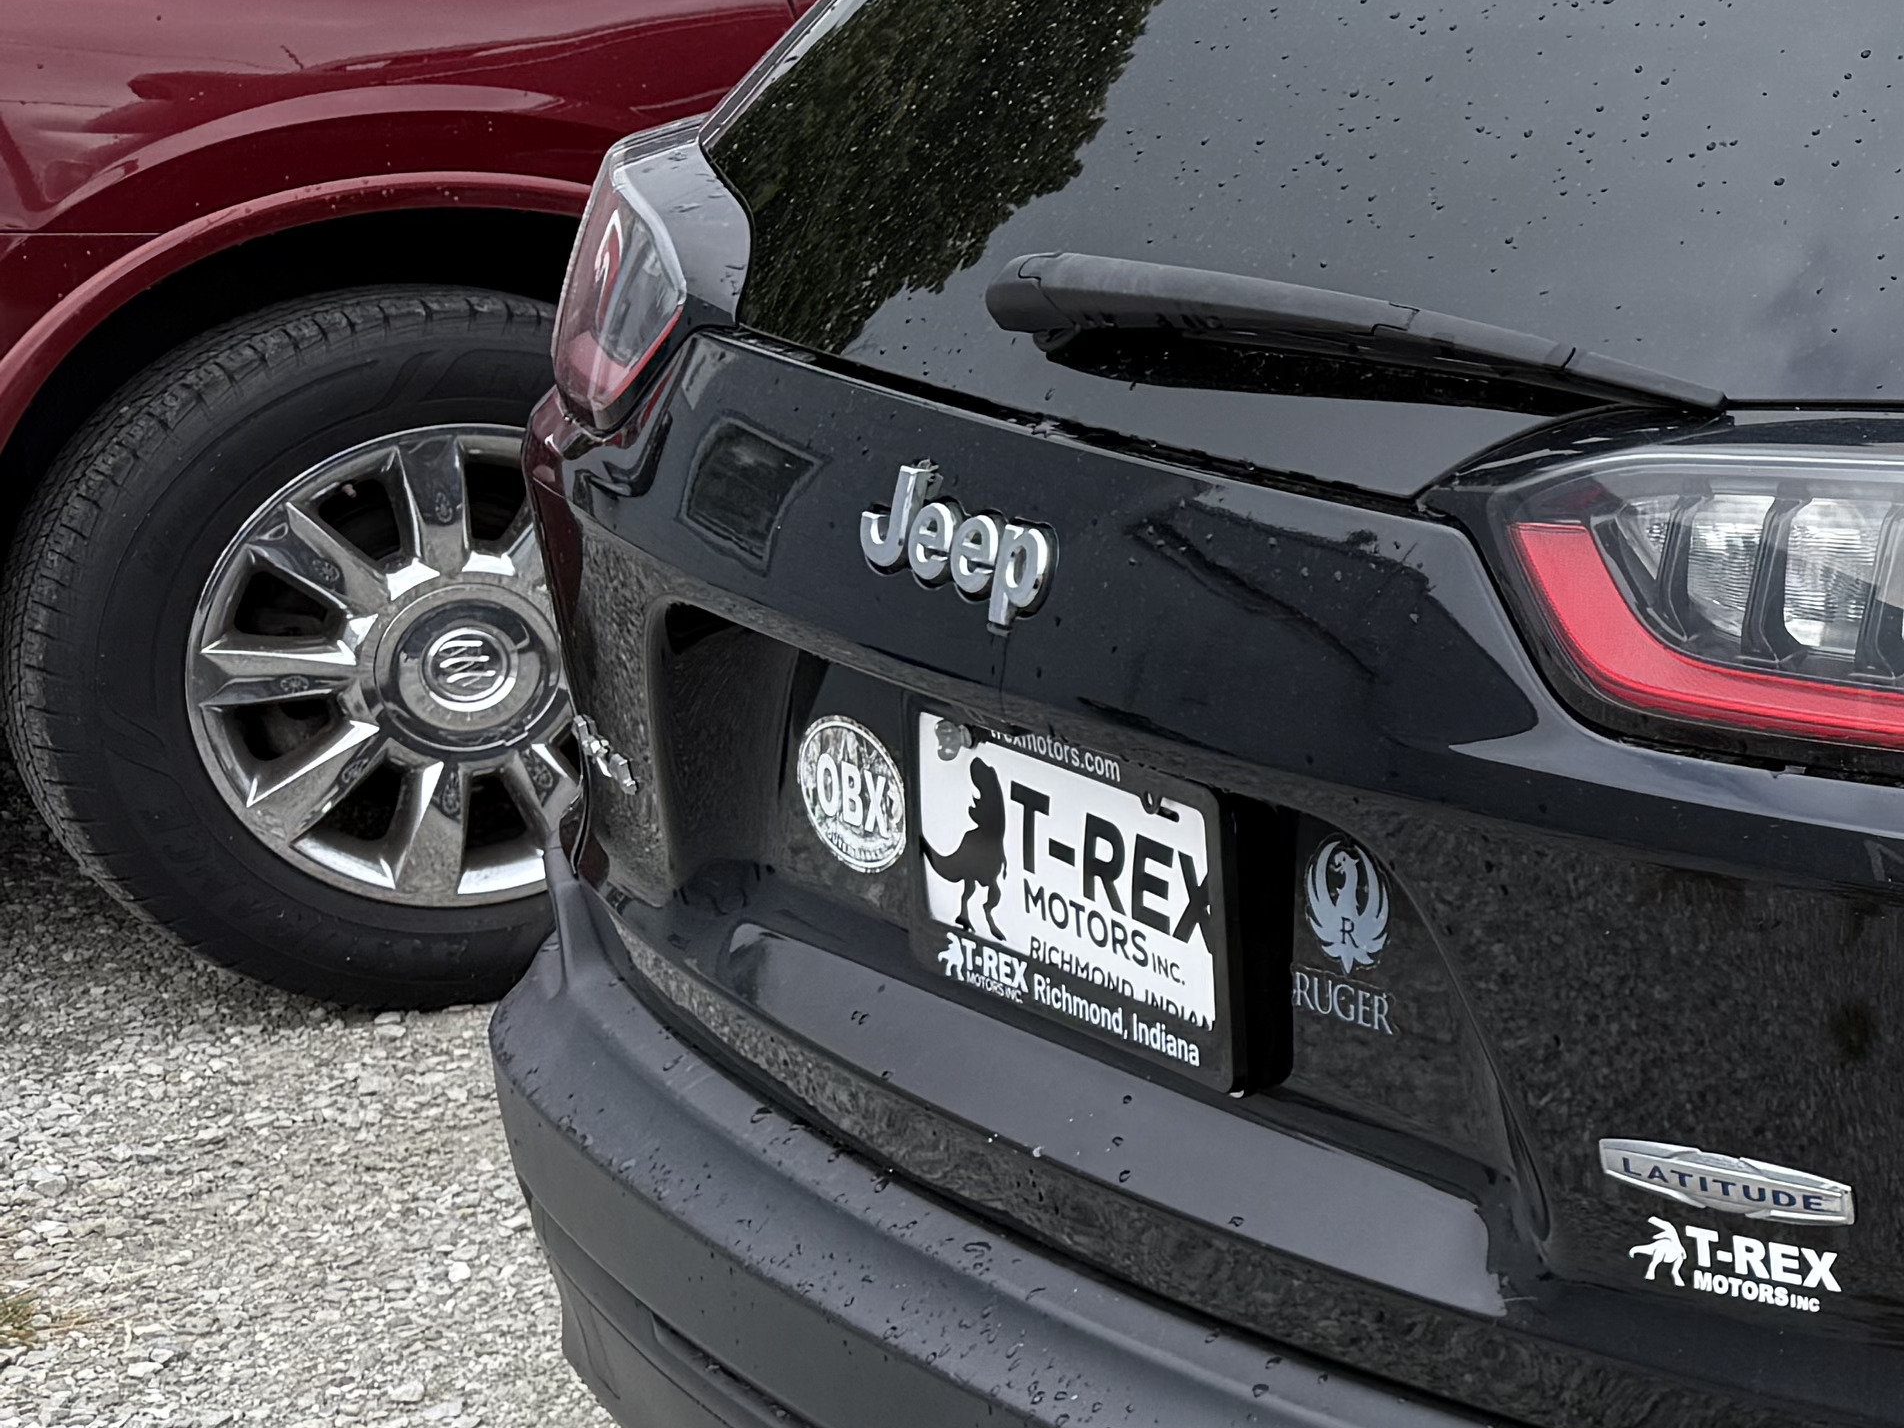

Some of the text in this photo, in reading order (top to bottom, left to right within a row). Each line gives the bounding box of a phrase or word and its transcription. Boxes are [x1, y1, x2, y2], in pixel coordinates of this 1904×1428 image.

[860, 460, 1051, 633] Jeep
[816, 753, 890, 840] OBX
[1010, 781, 1213, 955] T-REX
[961, 937, 1029, 994] T-REX
[1023, 876, 1186, 987] MOTORS INC.
[966, 972, 1005, 997] MOTORS
[1293, 970, 1394, 1036] RUGER
[1033, 973, 1201, 1068] Richmond, Indiana
[1621, 1155, 1825, 1212] LATITUDE
[1684, 1224, 1843, 1293] T-REX
[1693, 1269, 1821, 1313] MOTORS INC
